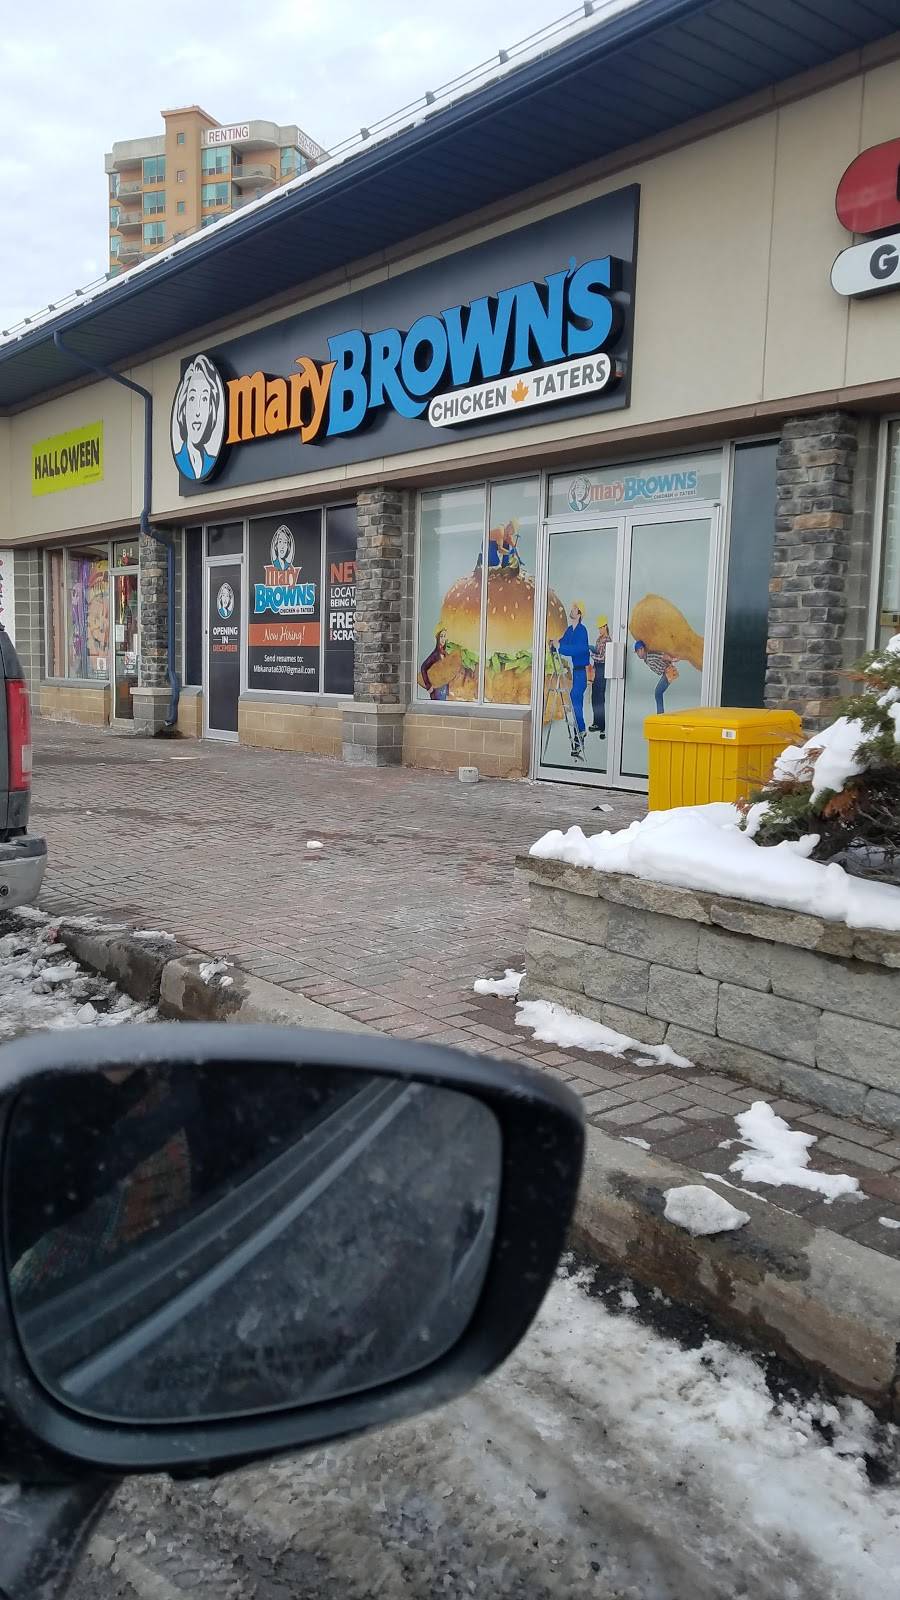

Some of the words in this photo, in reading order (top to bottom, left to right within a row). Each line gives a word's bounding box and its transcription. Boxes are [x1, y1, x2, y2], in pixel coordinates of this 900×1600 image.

[209, 126, 249, 142] RENTING
[431, 386, 507, 422] CHICKEN
[533, 360, 606, 397] TATERS
[35, 437, 99, 479] HALLOWEEN
[330, 599, 349, 607] BEING
[213, 627, 238, 635] OPENING
[263, 629, 278, 641] Now
[280, 625, 305, 646] Hiring!
[221, 636, 229, 644] IN
[264, 654, 275, 662] Send
